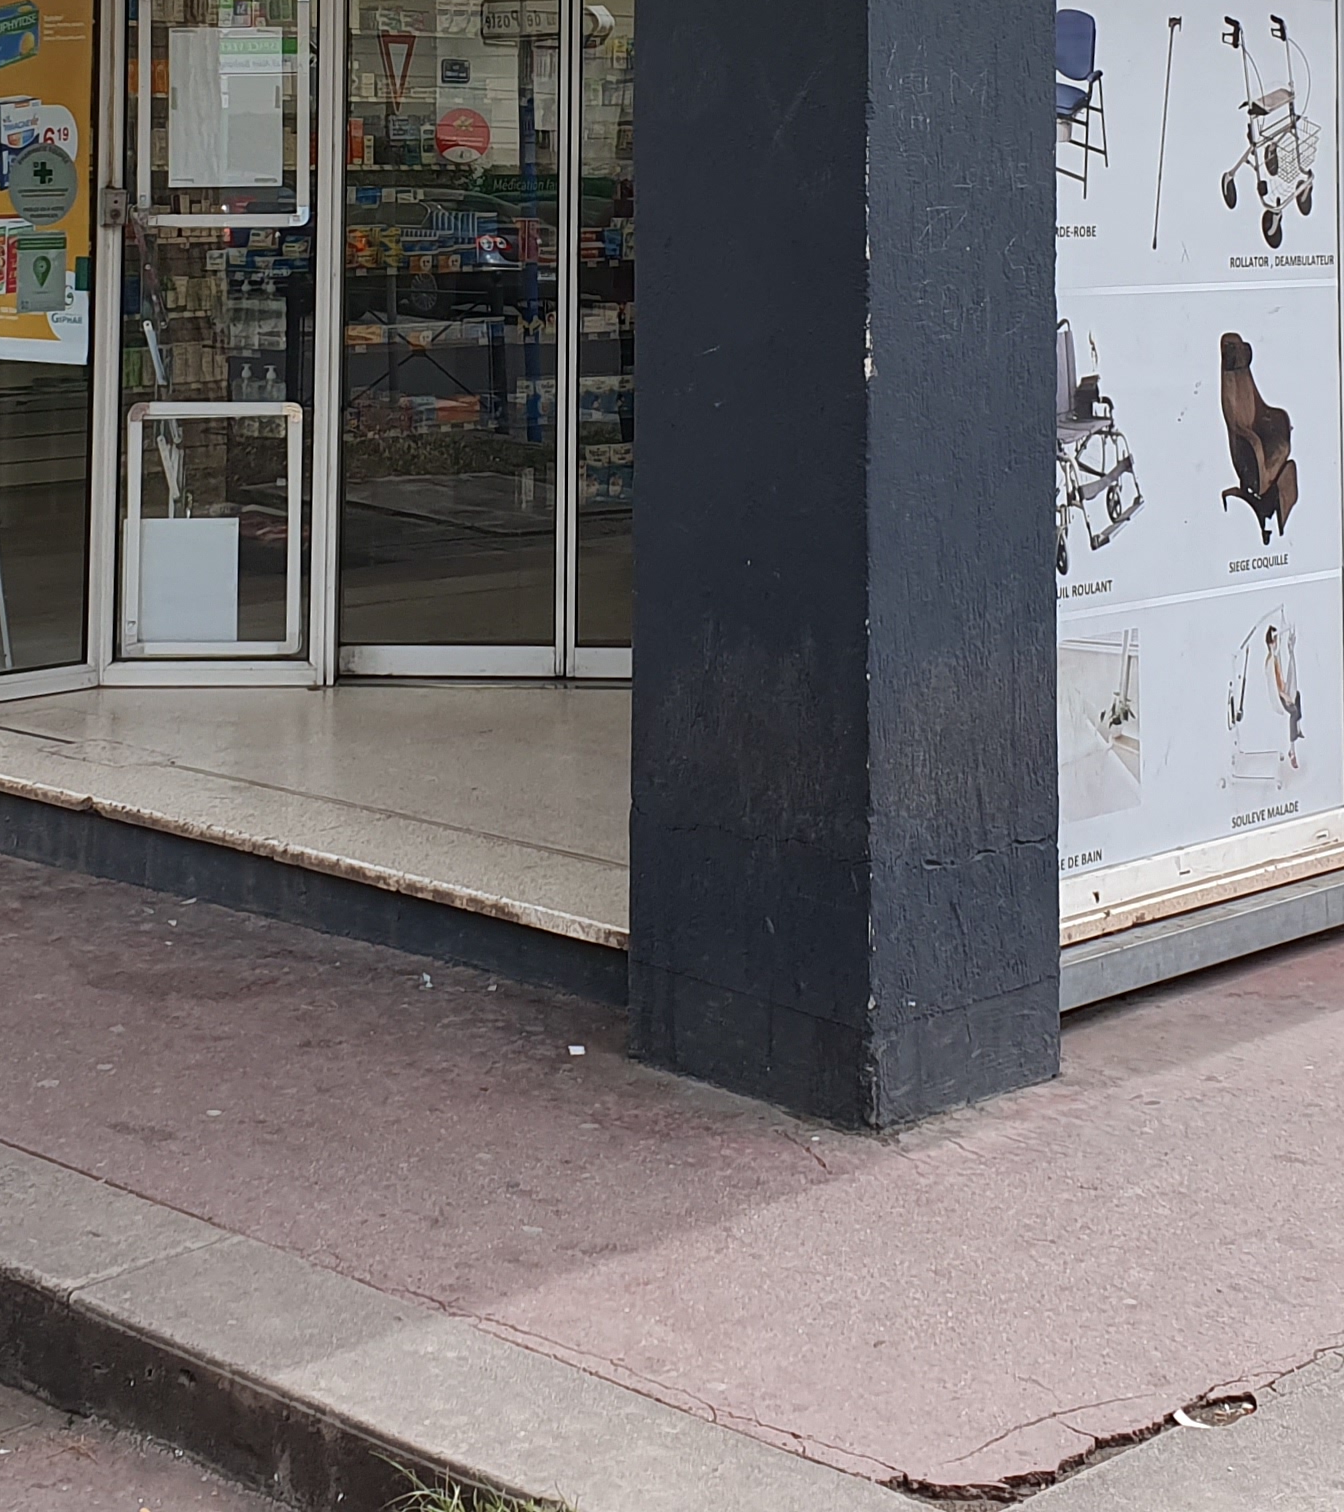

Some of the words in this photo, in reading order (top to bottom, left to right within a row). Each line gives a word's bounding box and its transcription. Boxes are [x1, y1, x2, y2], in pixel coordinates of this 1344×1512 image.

[493, 178, 544, 190] Médication
[1229, 256, 1269, 268] ROLLATOR
[1274, 254, 1334, 267] DEAMBULATEUR
[1229, 559, 1250, 573] SIEGE
[1252, 554, 1288, 569] COQUILLE
[1071, 579, 1113, 597] ROULANT
[1267, 800, 1299, 820] MALADE
[1067, 854, 1079, 868] DE
[1081, 849, 1103, 866] BAIN
